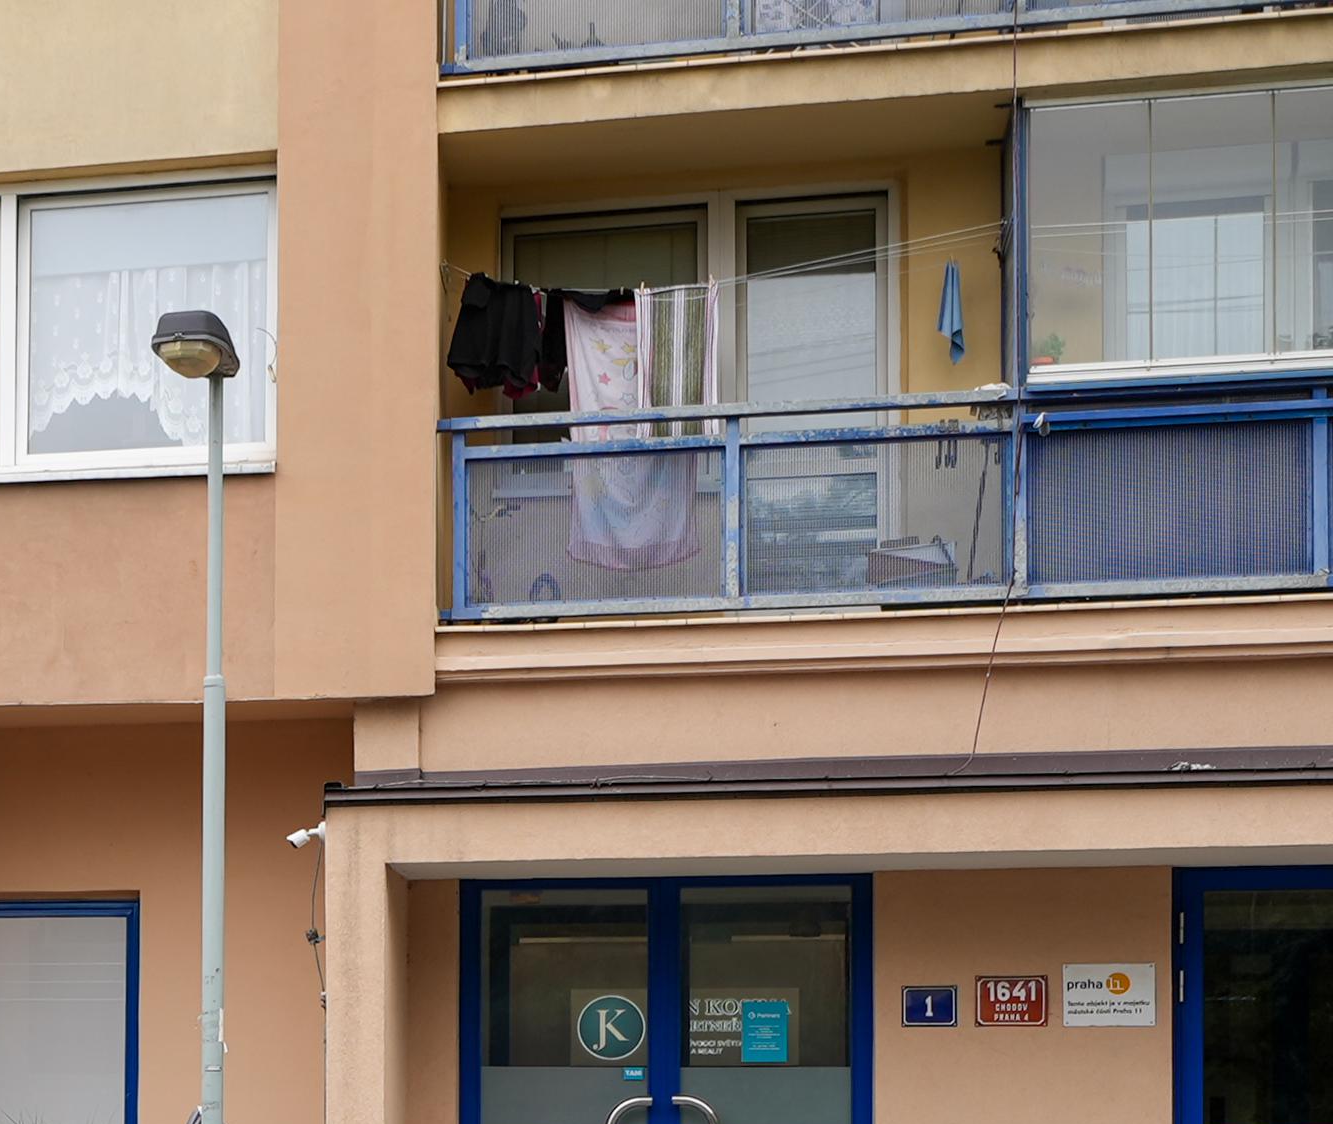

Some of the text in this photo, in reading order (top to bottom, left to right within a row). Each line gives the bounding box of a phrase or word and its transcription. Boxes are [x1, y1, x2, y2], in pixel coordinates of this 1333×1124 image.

[987, 980, 1036, 1002] 1641
[1067, 979, 1103, 992] praha
[925, 995, 933, 1017] 1
[995, 1003, 1028, 1012] CHODOV
[994, 1013, 1020, 1021] PRAHA
